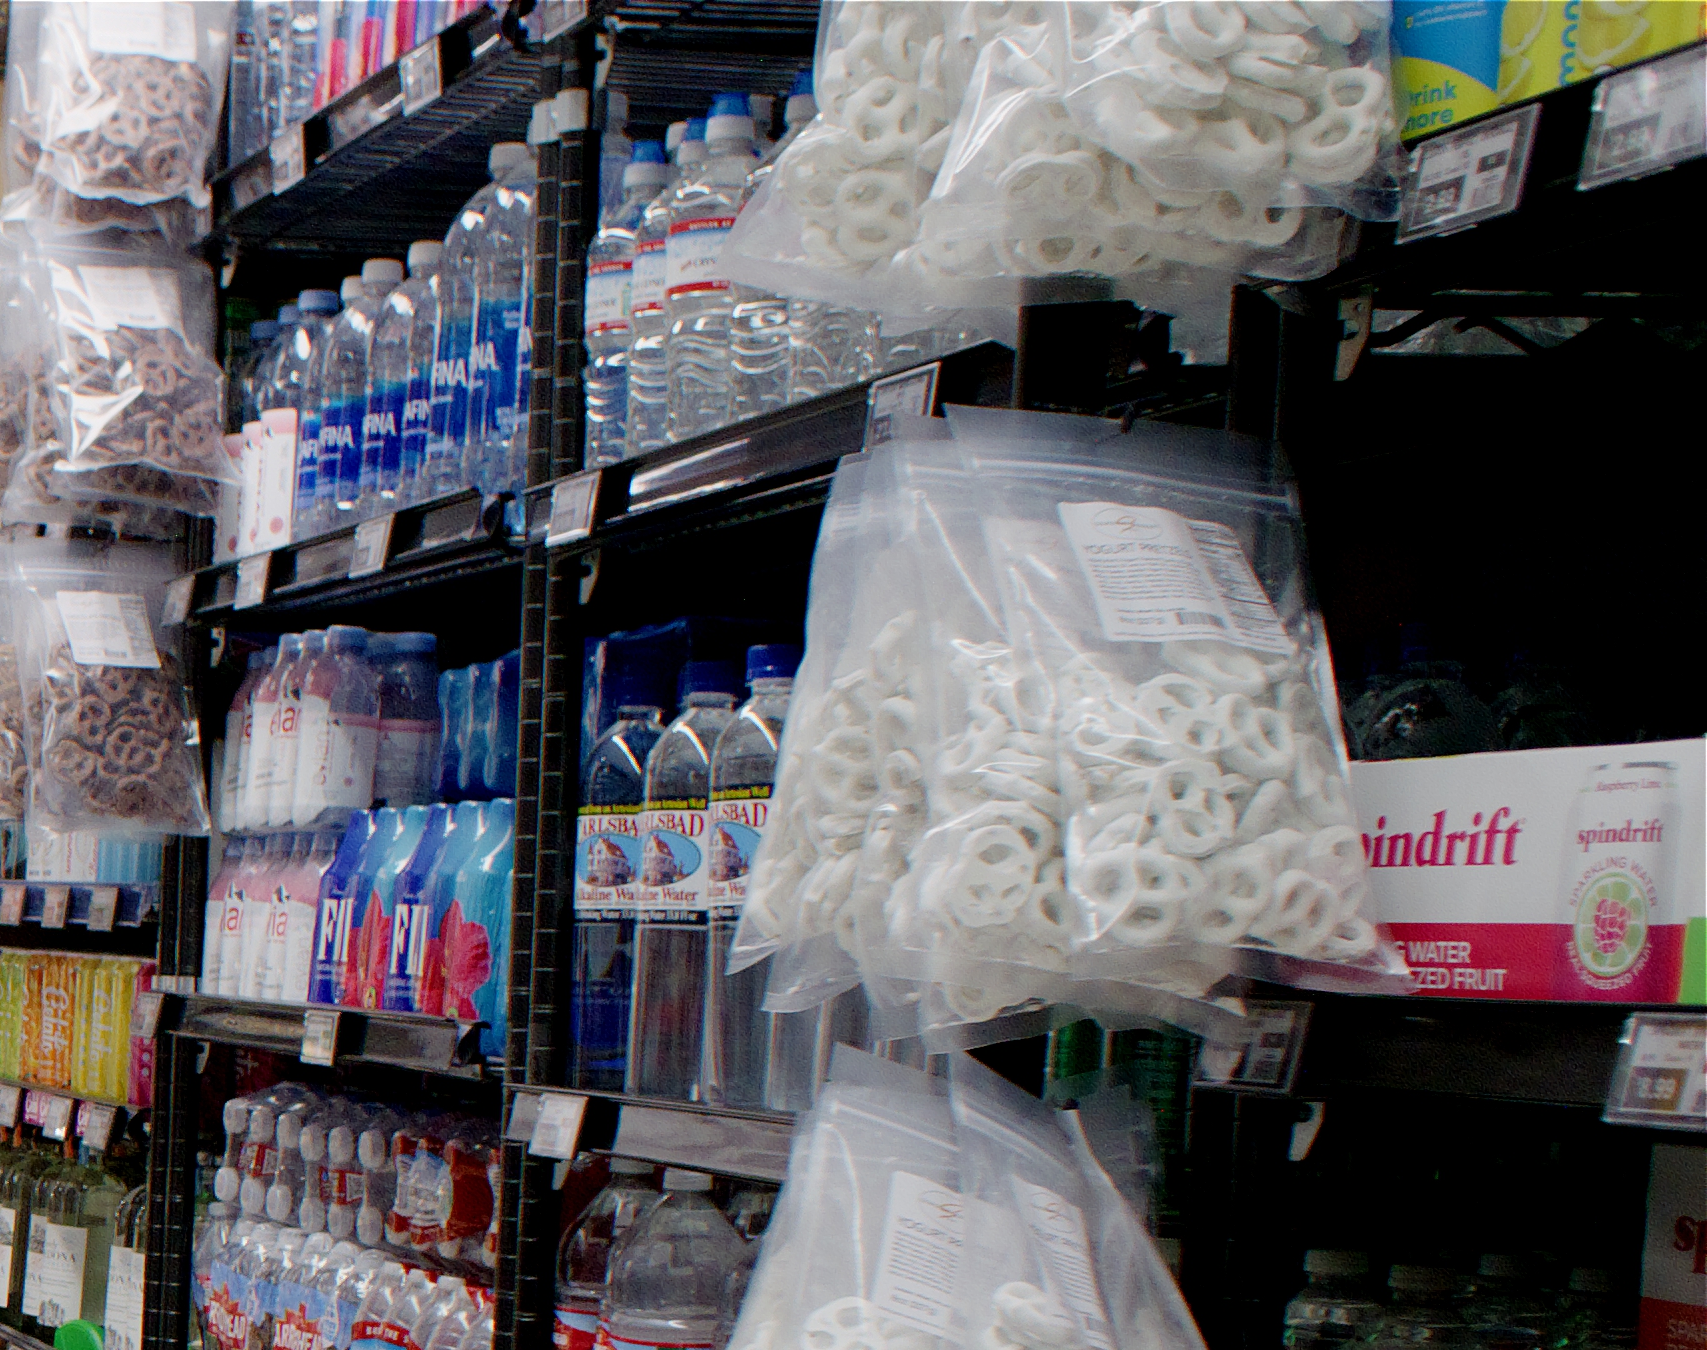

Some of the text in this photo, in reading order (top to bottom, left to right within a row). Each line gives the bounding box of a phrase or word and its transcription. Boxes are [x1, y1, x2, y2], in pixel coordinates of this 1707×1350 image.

[1576, 816, 1664, 853] spindrift
[662, 887, 698, 903] Water
[1407, 940, 1472, 966] WATER
[1453, 968, 1507, 991] FRUIT
